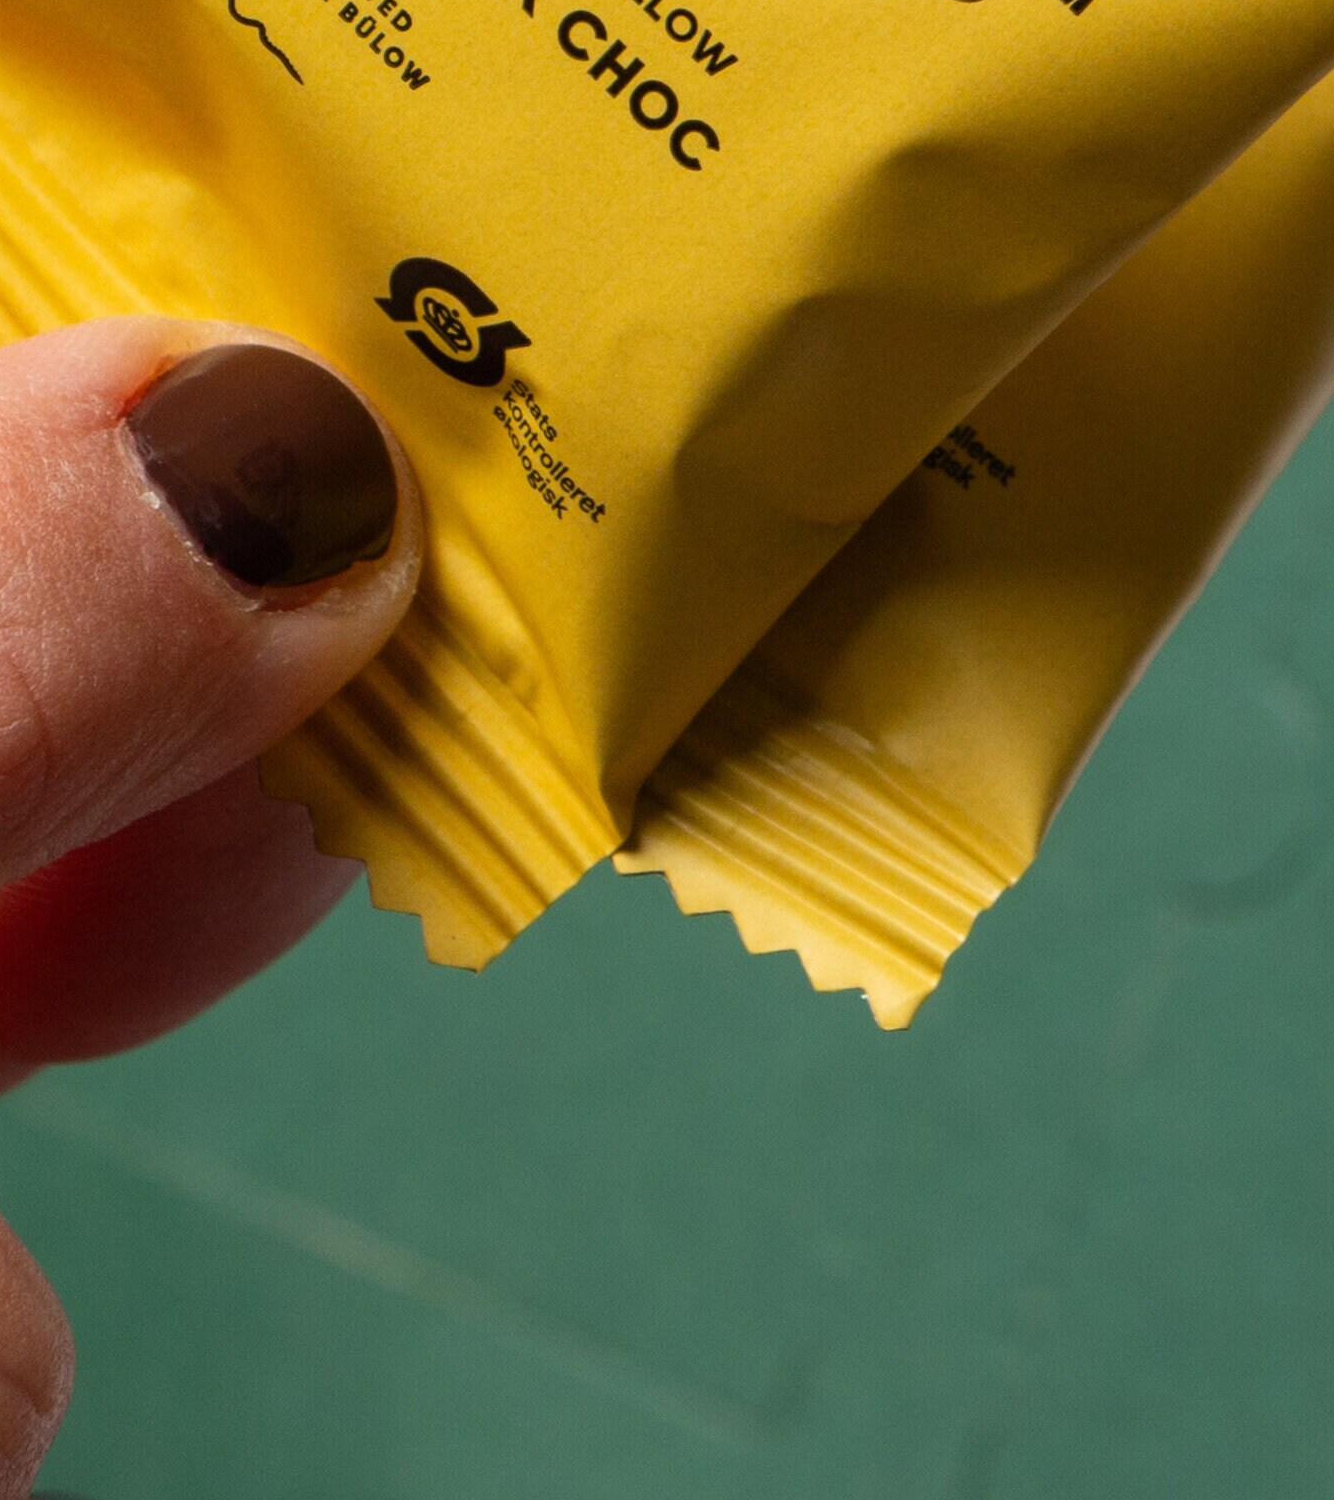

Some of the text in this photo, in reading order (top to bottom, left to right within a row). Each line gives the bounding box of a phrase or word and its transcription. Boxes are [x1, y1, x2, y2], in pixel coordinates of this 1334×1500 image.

[338, 1, 431, 91] BÜLOW
[557, 10, 720, 171] CHOC
[501, 388, 606, 524] kontrolleret
[509, 378, 558, 442] Stats
